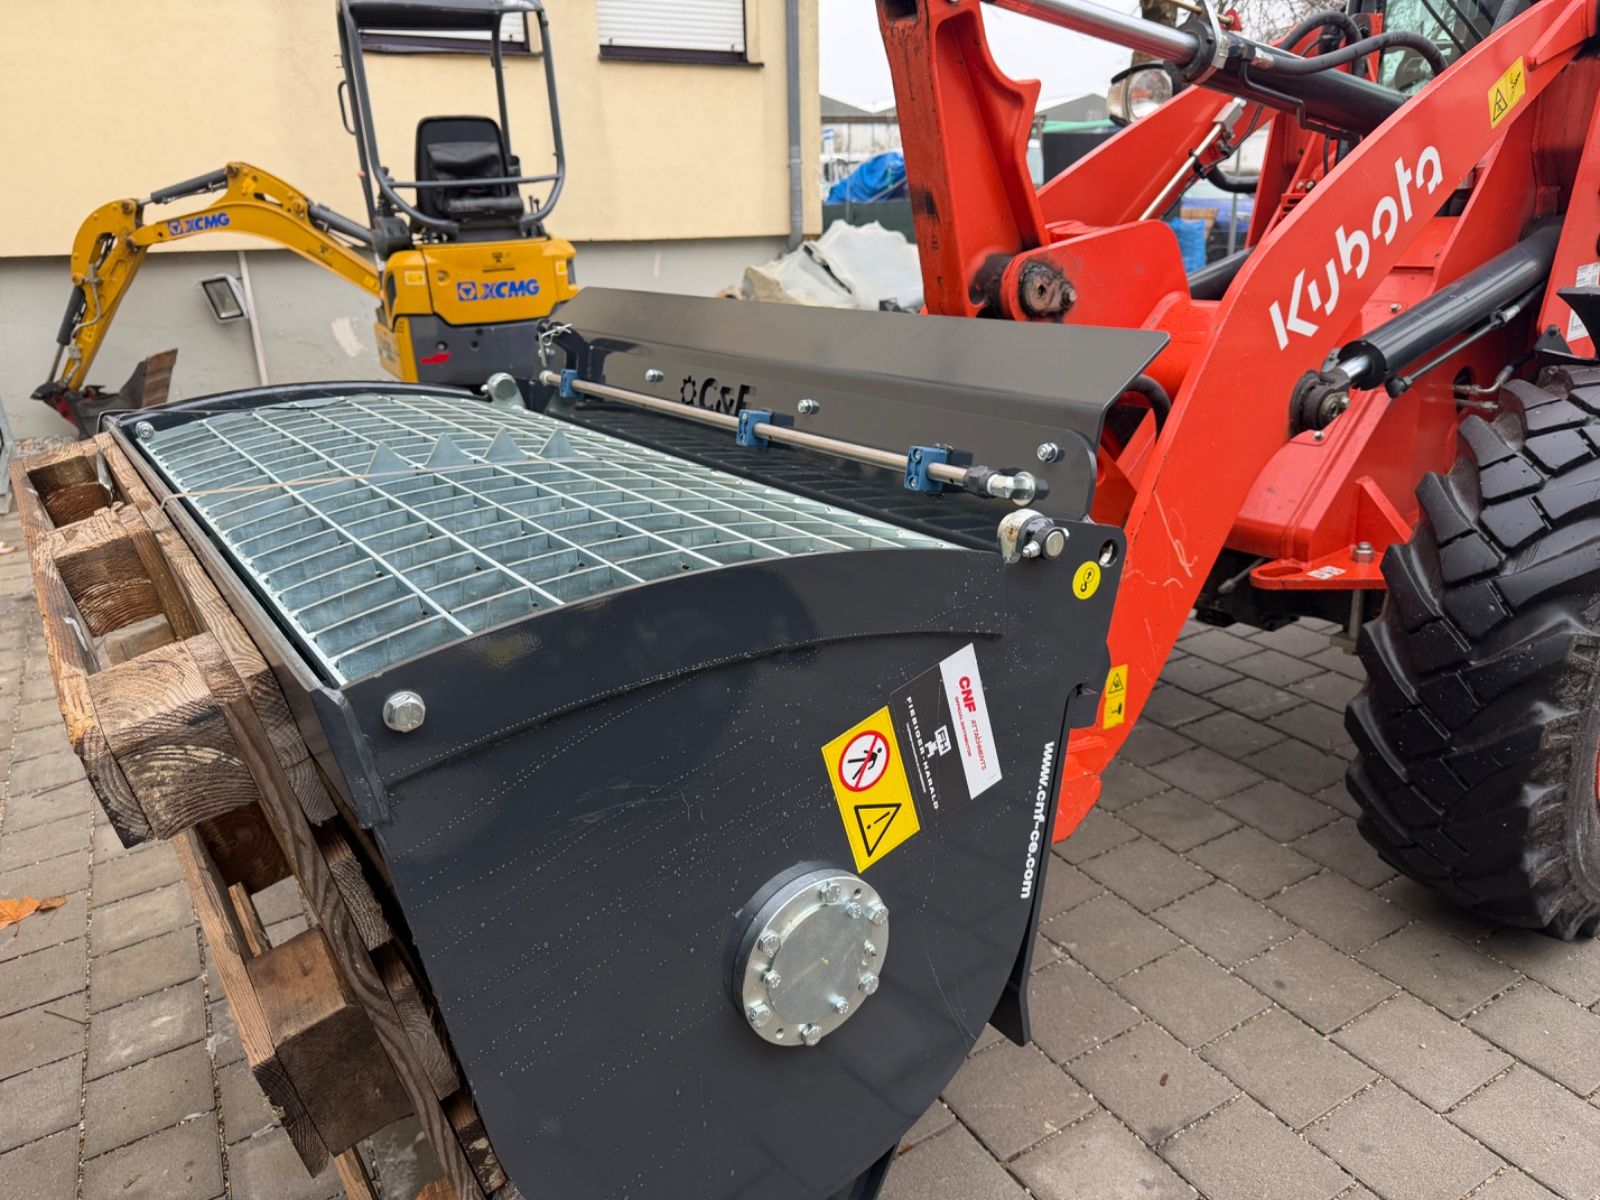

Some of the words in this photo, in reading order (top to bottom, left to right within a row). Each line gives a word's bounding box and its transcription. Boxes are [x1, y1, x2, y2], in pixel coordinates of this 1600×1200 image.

[184, 212, 230, 232] XCMG
[1269, 145, 1443, 351] Kubota
[481, 279, 539, 299] XCMG
[957, 676, 976, 713] CNF
[1021, 741, 1054, 899] www.cnf-ce.com
